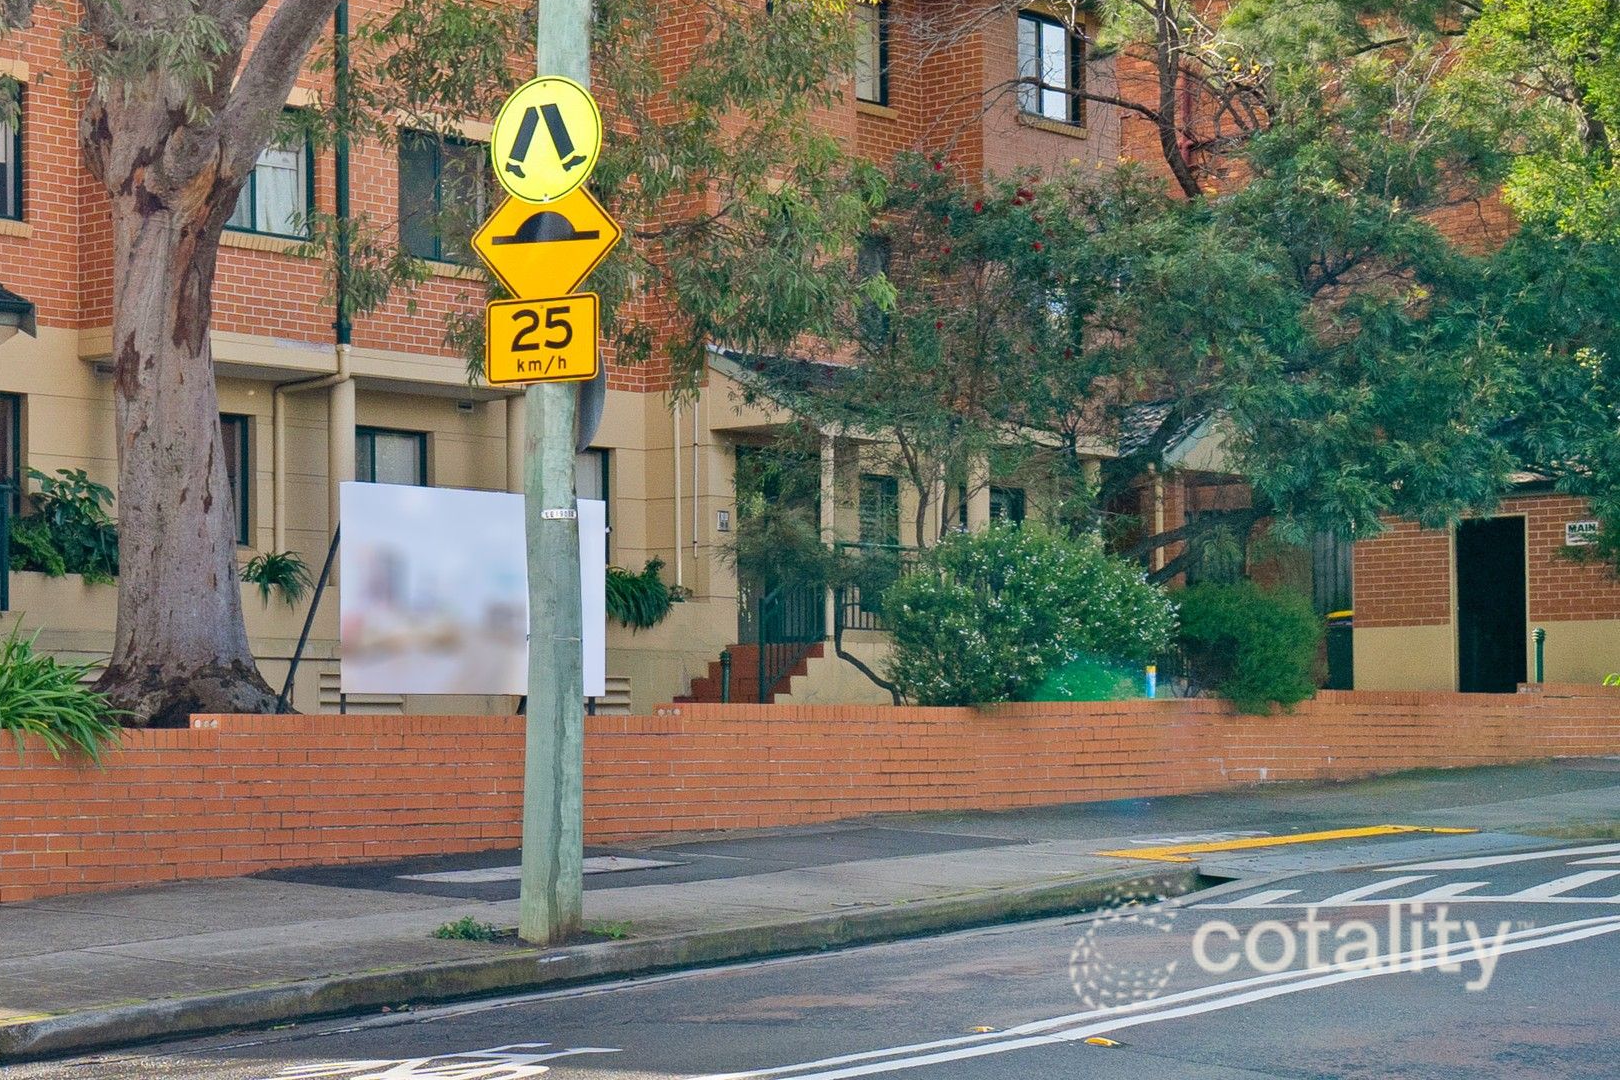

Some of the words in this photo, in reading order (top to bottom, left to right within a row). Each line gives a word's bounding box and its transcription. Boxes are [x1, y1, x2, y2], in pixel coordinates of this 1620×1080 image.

[511, 306, 573, 352] 25
[516, 355, 568, 376] km/h
[1568, 523, 1596, 533] MAIN
